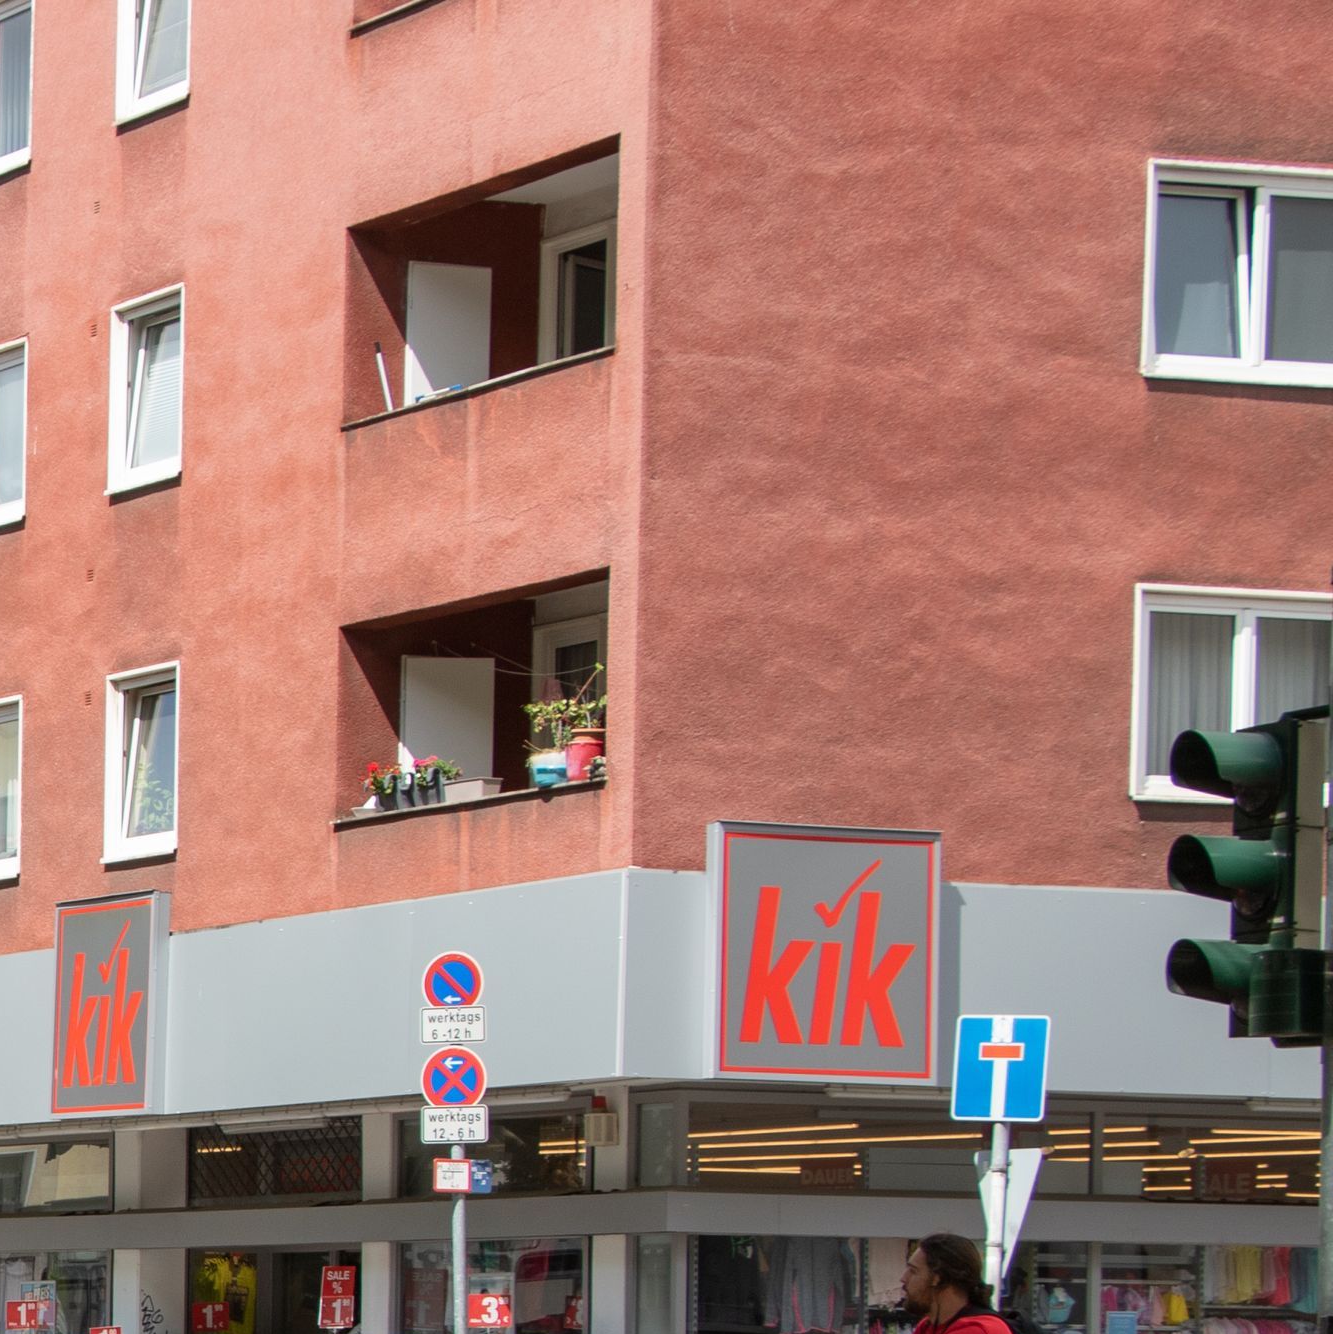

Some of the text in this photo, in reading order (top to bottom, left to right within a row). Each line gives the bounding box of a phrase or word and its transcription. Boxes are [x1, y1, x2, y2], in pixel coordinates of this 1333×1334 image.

[739, 859, 917, 1048] kik
[62, 919, 144, 1088] kik
[428, 1012, 481, 1025] werktags
[432, 1029, 438, 1040] 6
[464, 1028, 471, 1039] h
[429, 1111, 481, 1123] werktags
[433, 1129, 445, 1139] 12
[458, 1128, 464, 1139] 6
[468, 1128, 475, 1138] h
[327, 1270, 350, 1281] SALE
[332, 1281, 343, 1294] %
